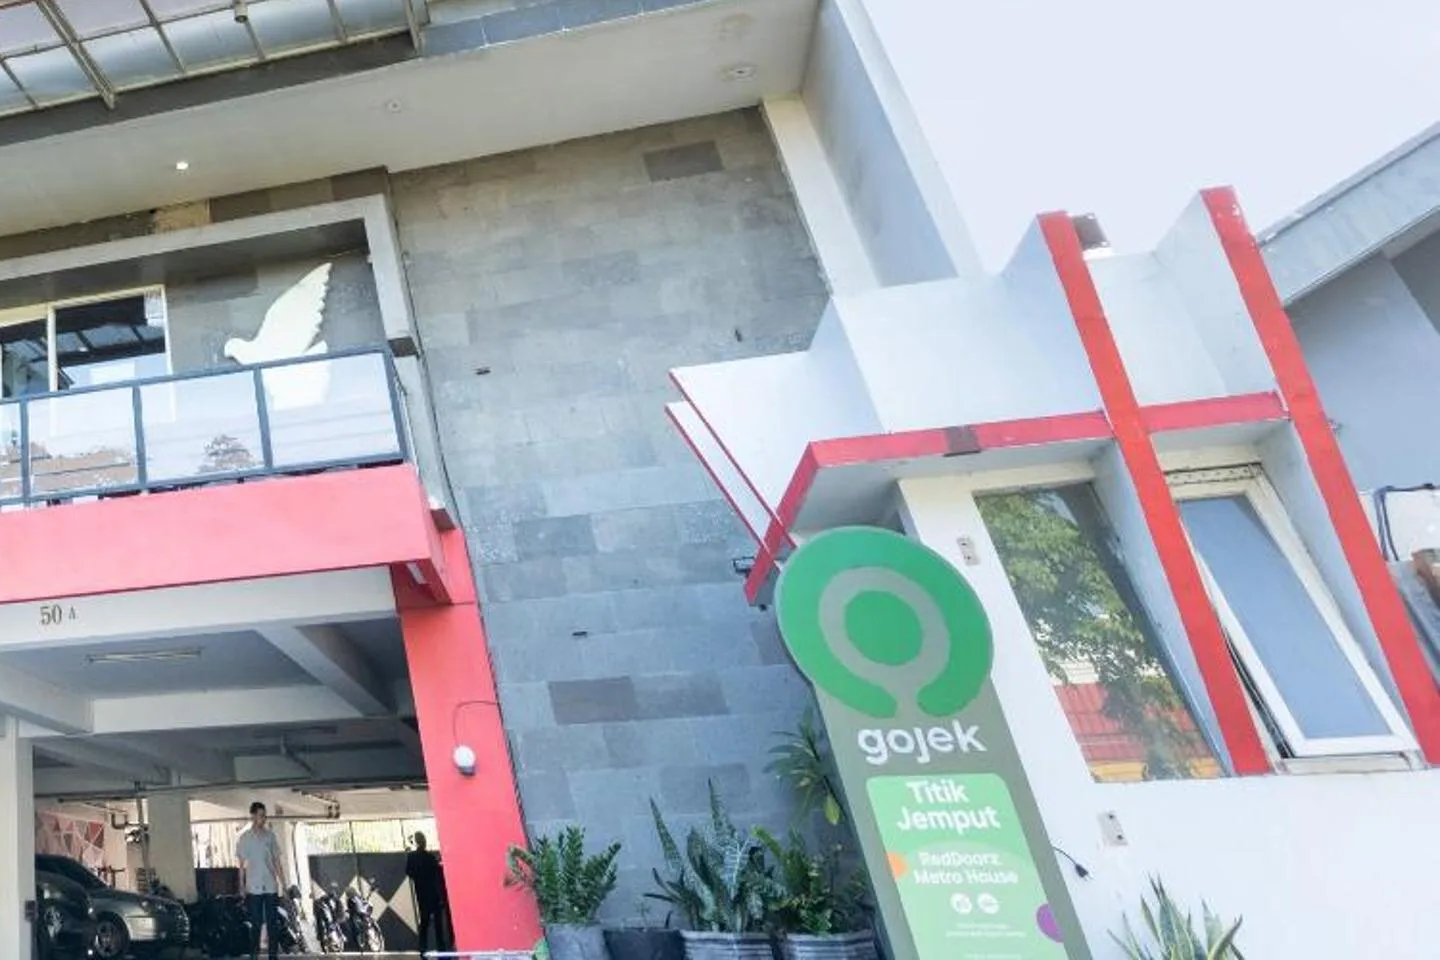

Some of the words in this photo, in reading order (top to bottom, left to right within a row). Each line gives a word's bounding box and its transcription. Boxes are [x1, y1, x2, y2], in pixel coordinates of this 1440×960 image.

[40, 603, 62, 625] 50
[858, 719, 987, 765] gojek
[906, 778, 970, 804] Titik
[897, 806, 1001, 835] Jemput
[914, 868, 963, 884] Metro
[966, 868, 1019, 885] House
